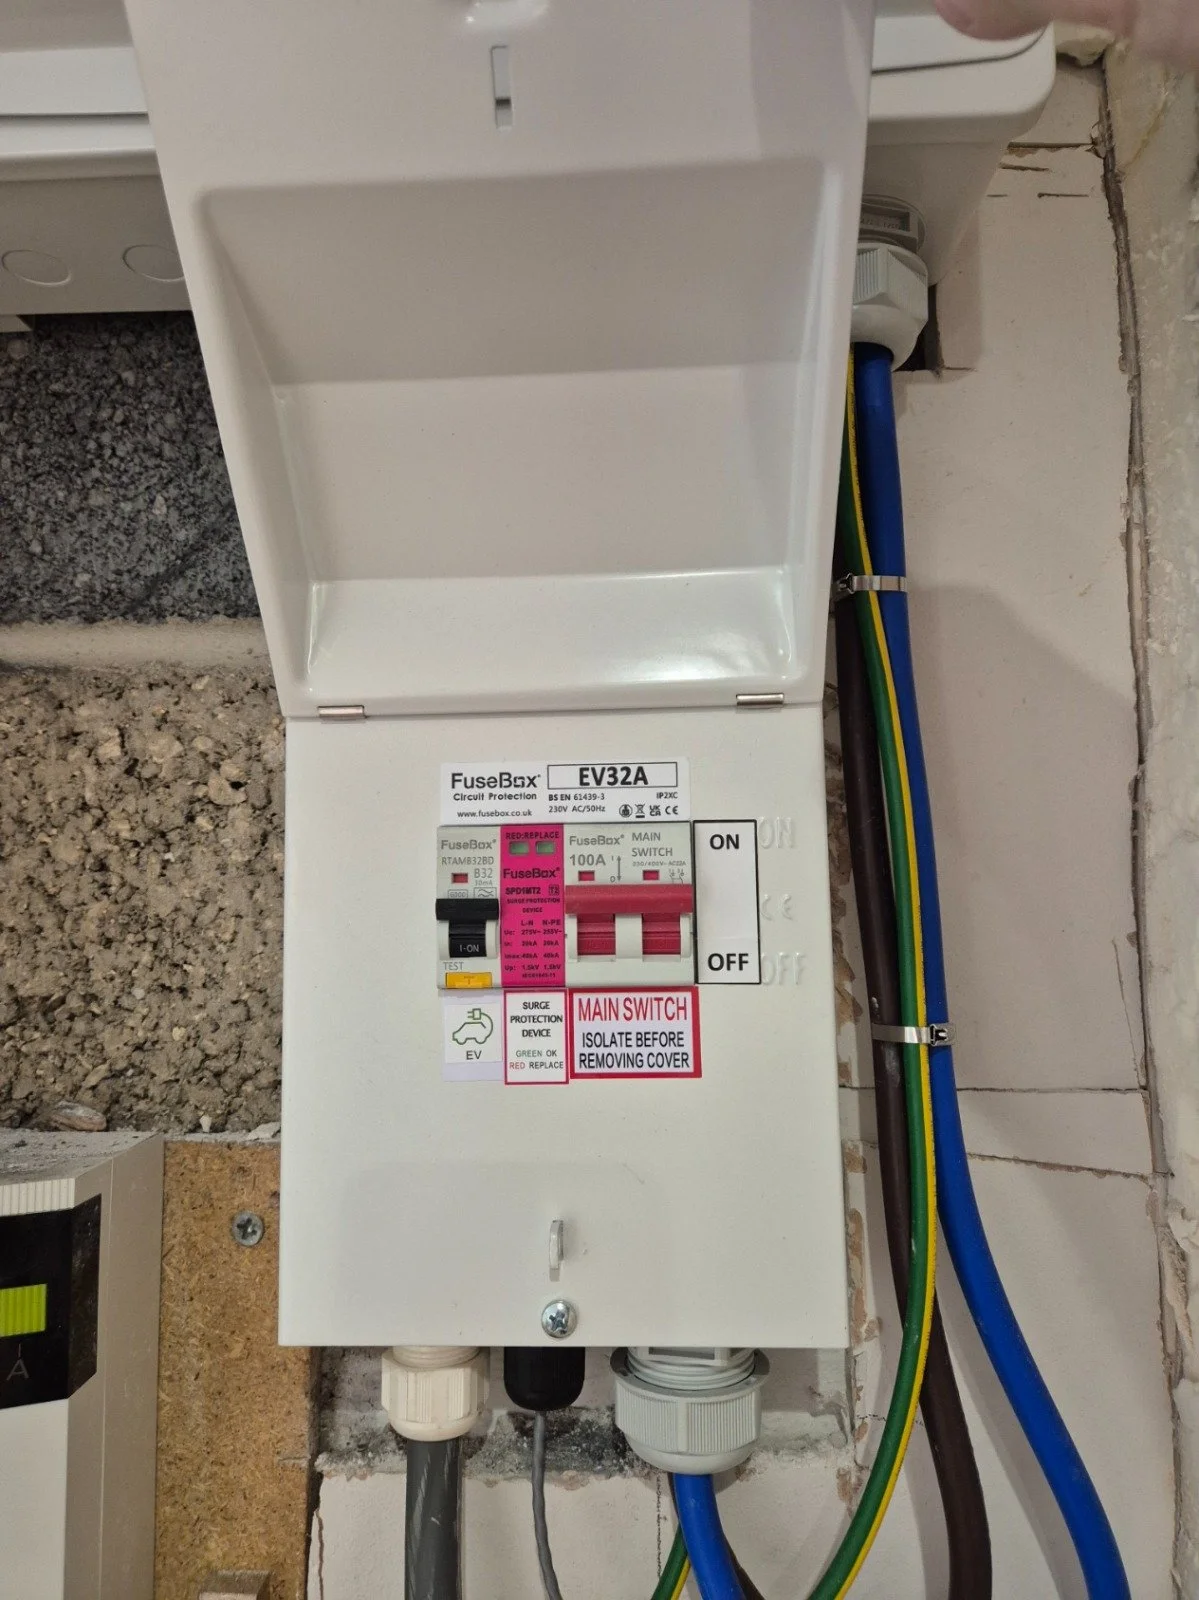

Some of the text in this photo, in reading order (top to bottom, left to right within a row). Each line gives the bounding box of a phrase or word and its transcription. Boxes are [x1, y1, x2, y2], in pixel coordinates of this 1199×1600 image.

[451, 772, 538, 789] FuseBox
[579, 766, 649, 786] EV32A
[453, 792, 537, 801] Circuit Protection
[560, 793, 571, 801] EN
[573, 793, 605, 801] 61439-3
[457, 809, 532, 818] www.fusebox.co.uk
[572, 804, 606, 813] AC/50Hz
[631, 832, 661, 842] MAIN
[759, 817, 794, 849] ON
[440, 839, 493, 850] FuseBox
[569, 835, 621, 846] FuseBox
[709, 833, 740, 850] ON
[631, 847, 673, 857] SWITCH
[569, 854, 606, 866] 100A
[474, 868, 493, 878] B32
[503, 867, 557, 879] FuseBox
[443, 961, 464, 971] TEST
[707, 952, 749, 971] OFF
[760, 952, 805, 985] OFF
[522, 1001, 551, 1010] SURGE
[578, 996, 688, 1022] MAIN SWITCH
[510, 1014, 563, 1024] PROTECTION
[521, 1029, 552, 1038] DEVICE
[582, 1031, 684, 1049] ISOLATE BEFORE
[466, 1050, 482, 1060] EV
[516, 1049, 557, 1058] GREEN OK
[509, 1061, 564, 1070] RED REPLACE
[579, 1052, 690, 1069] REMOVING COVER
